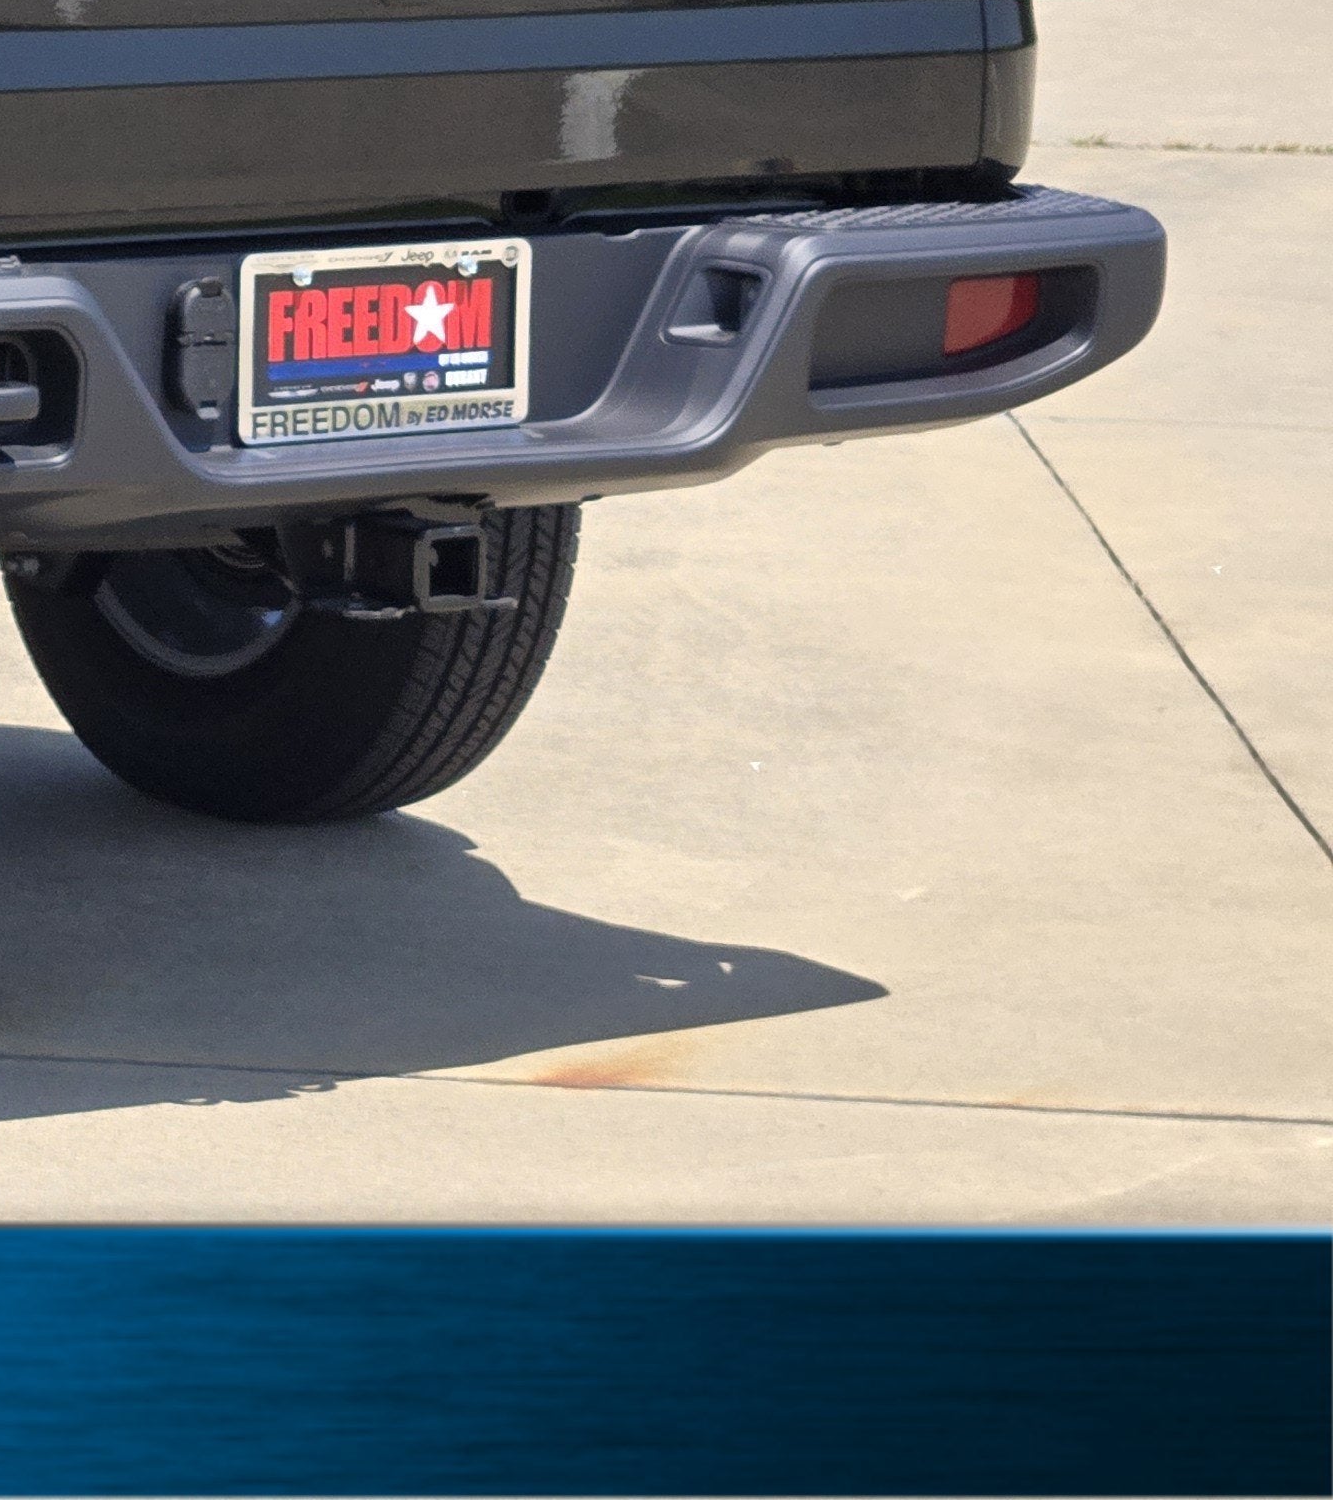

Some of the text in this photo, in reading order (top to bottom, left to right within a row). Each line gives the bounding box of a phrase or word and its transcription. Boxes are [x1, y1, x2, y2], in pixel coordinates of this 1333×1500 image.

[401, 250, 435, 263] Jeep
[268, 278, 493, 363] FREEDOM
[251, 401, 401, 440] FREEDOM
[425, 405, 448, 423] ED
[450, 399, 515, 421] MORSE
